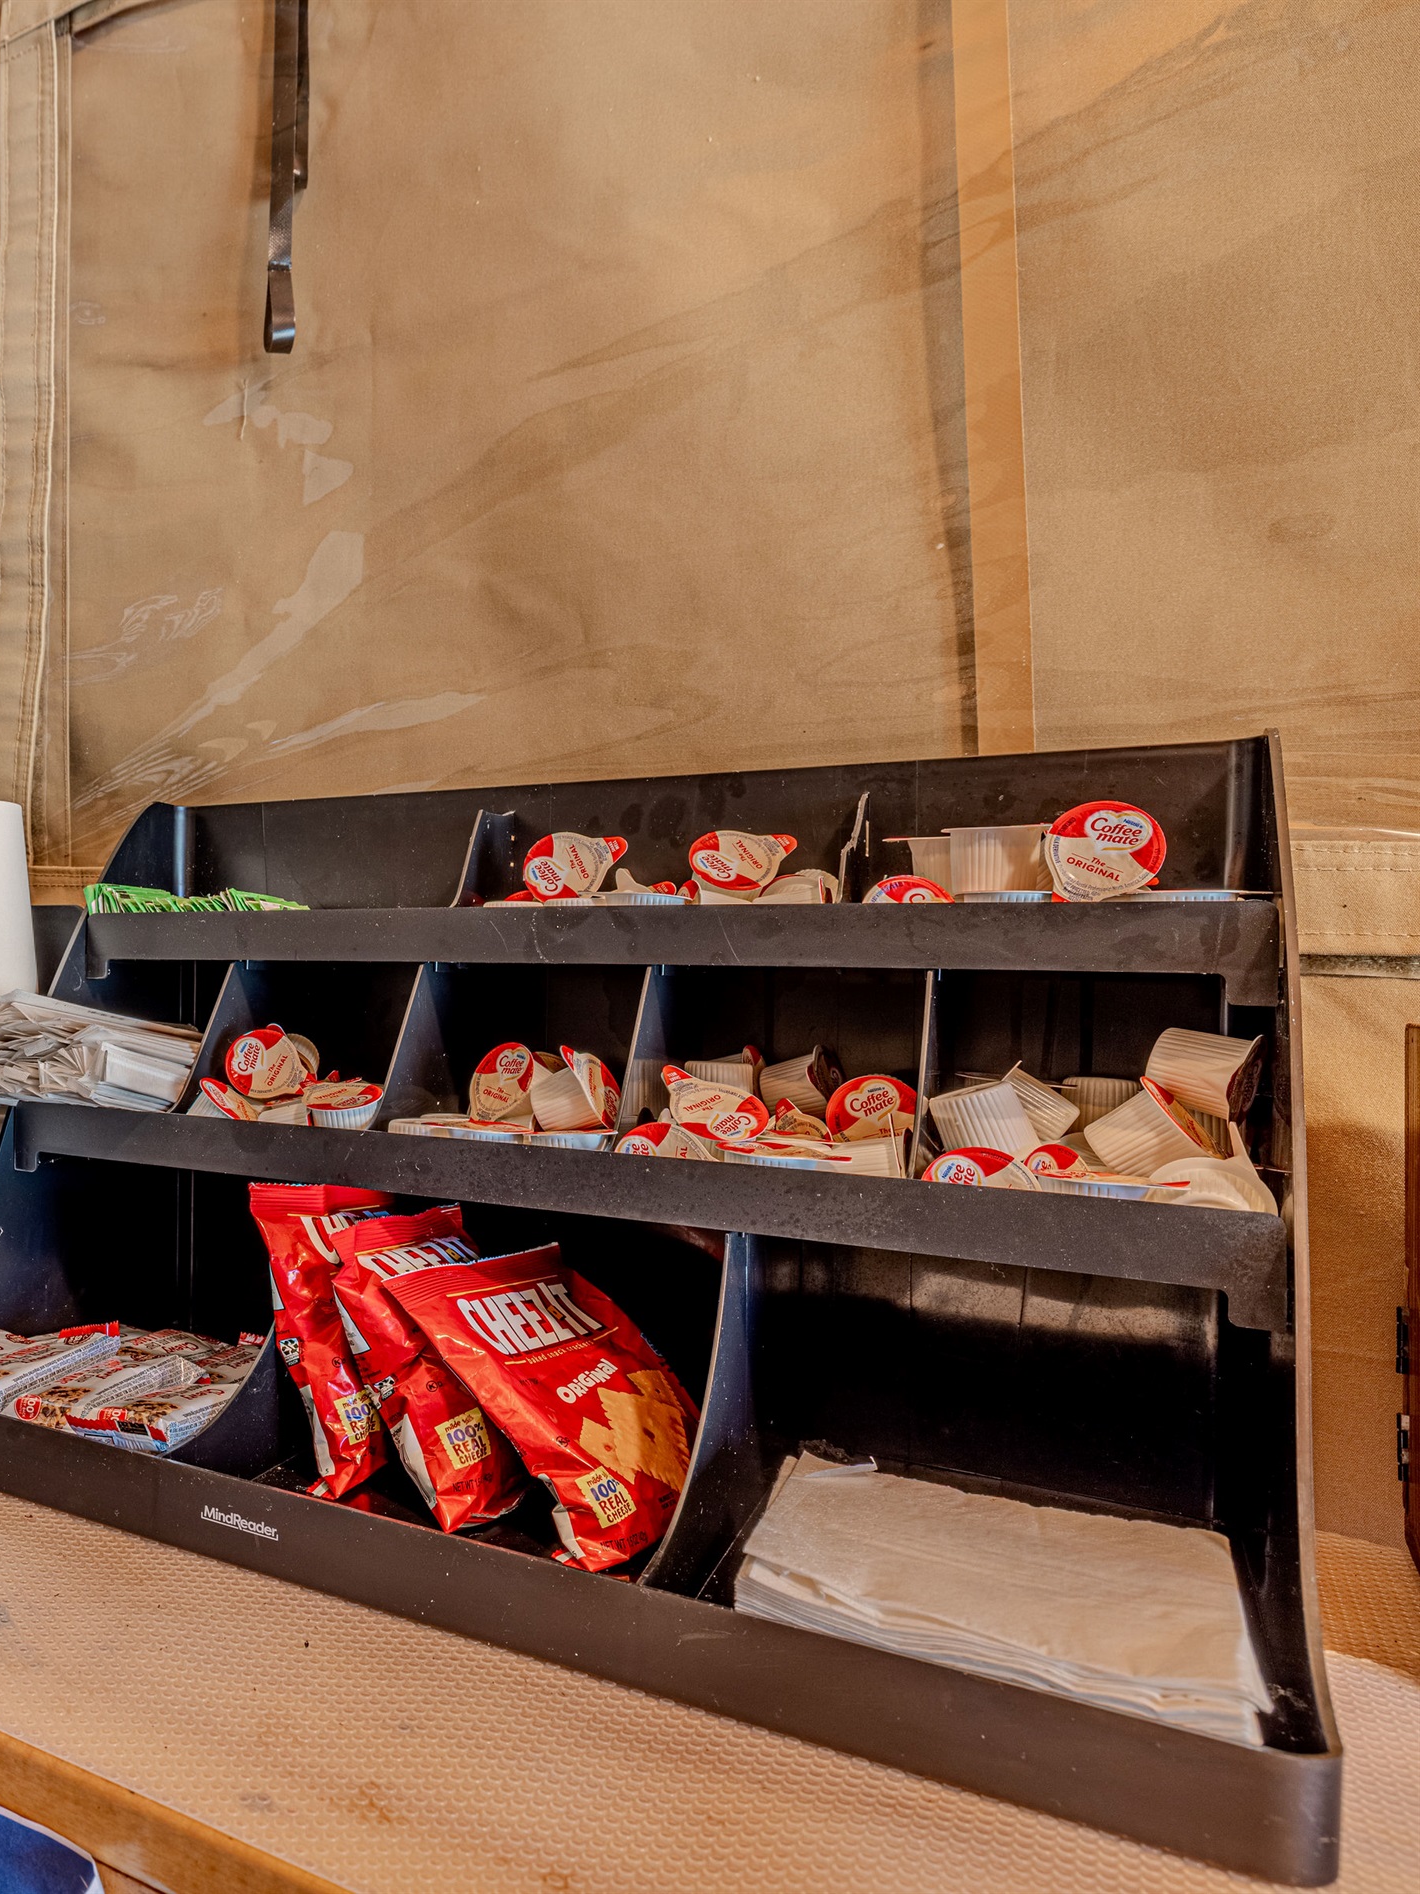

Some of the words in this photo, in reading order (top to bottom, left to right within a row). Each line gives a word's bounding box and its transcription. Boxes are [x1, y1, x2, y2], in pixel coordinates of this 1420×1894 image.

[1091, 817, 1142, 837] Coffee
[1096, 832, 1140, 846] mate
[568, 843, 590, 879] ORIGINAL
[707, 853, 733, 872] mate
[735, 839, 763, 870] ORIGINAL
[1091, 856, 1106, 867] The
[534, 864, 558, 892] Coffee
[540, 860, 562, 882] mate
[701, 856, 731, 879] Coffee
[1067, 856, 1120, 882] ORIGINAL
[238, 1042, 255, 1072] Coffee
[249, 1043, 261, 1070] mate
[499, 1055, 524, 1068] Coffee
[266, 1054, 289, 1087] ORIGINAL
[268, 1063, 277, 1073] The
[502, 1066, 523, 1075] mate
[482, 1088, 510, 1103] ORIGINAL
[496, 1086, 504, 1094] The
[850, 1089, 890, 1113] Coffee
[683, 1094, 721, 1112] ORIGINAL
[863, 1096, 895, 1118] mate
[713, 1114, 735, 1131] mate
[721, 1115, 751, 1135] Coffee
[161, 1342, 199, 1354] Chewy
[526, 1353, 547, 1365] baked
[548, 1347, 566, 1360] snack
[566, 1339, 594, 1355] crackers
[445, 1420, 461, 1432] made
[446, 1422, 484, 1445] 100%
[453, 1435, 487, 1457] REAL
[458, 1447, 488, 1465] CHEESE
[586, 1473, 603, 1488] made
[590, 1478, 620, 1502] 100%
[598, 1491, 629, 1516] REAL
[606, 1502, 633, 1524] CHEESE
[203, 1504, 278, 1538] MindReader
[615, 1539, 627, 1551] WT
